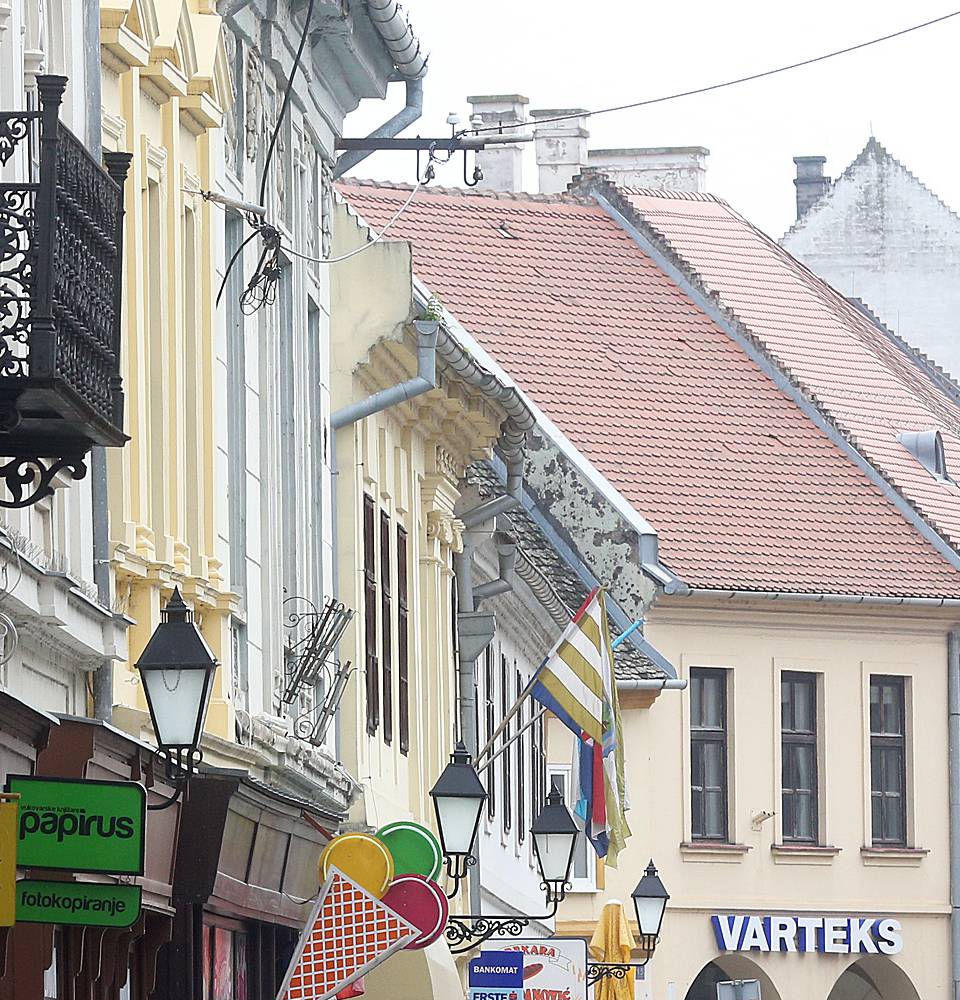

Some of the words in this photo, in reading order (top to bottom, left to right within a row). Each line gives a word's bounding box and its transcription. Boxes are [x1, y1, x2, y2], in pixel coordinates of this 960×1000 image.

[19, 808, 135, 843] papirus
[21, 891, 126, 917] fotokopiranje
[711, 914, 904, 955] VARTEKS
[504, 945, 556, 958] KARA
[473, 965, 519, 974] BANKOMAT
